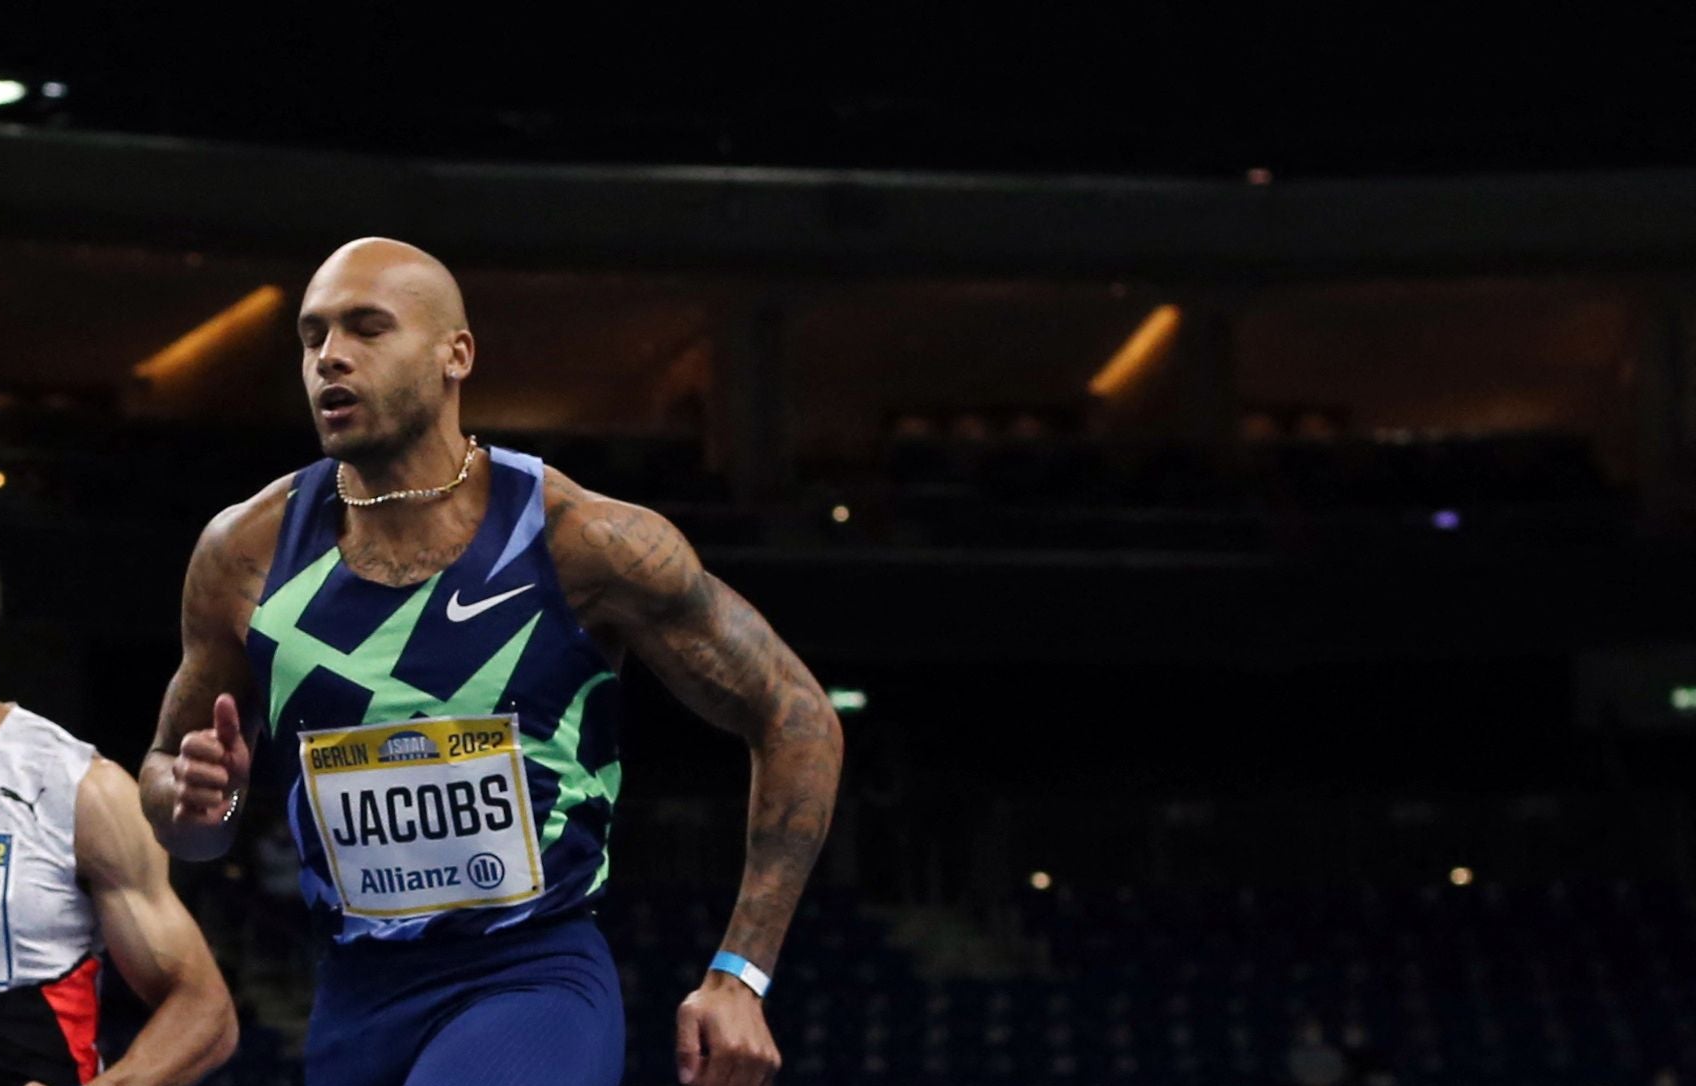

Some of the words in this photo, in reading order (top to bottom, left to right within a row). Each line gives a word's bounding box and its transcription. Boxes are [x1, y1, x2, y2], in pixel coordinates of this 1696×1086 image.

[311, 744, 370, 770] BERLIN
[332, 774, 514, 847] JACOBS
[360, 866, 461, 895] Allianz
